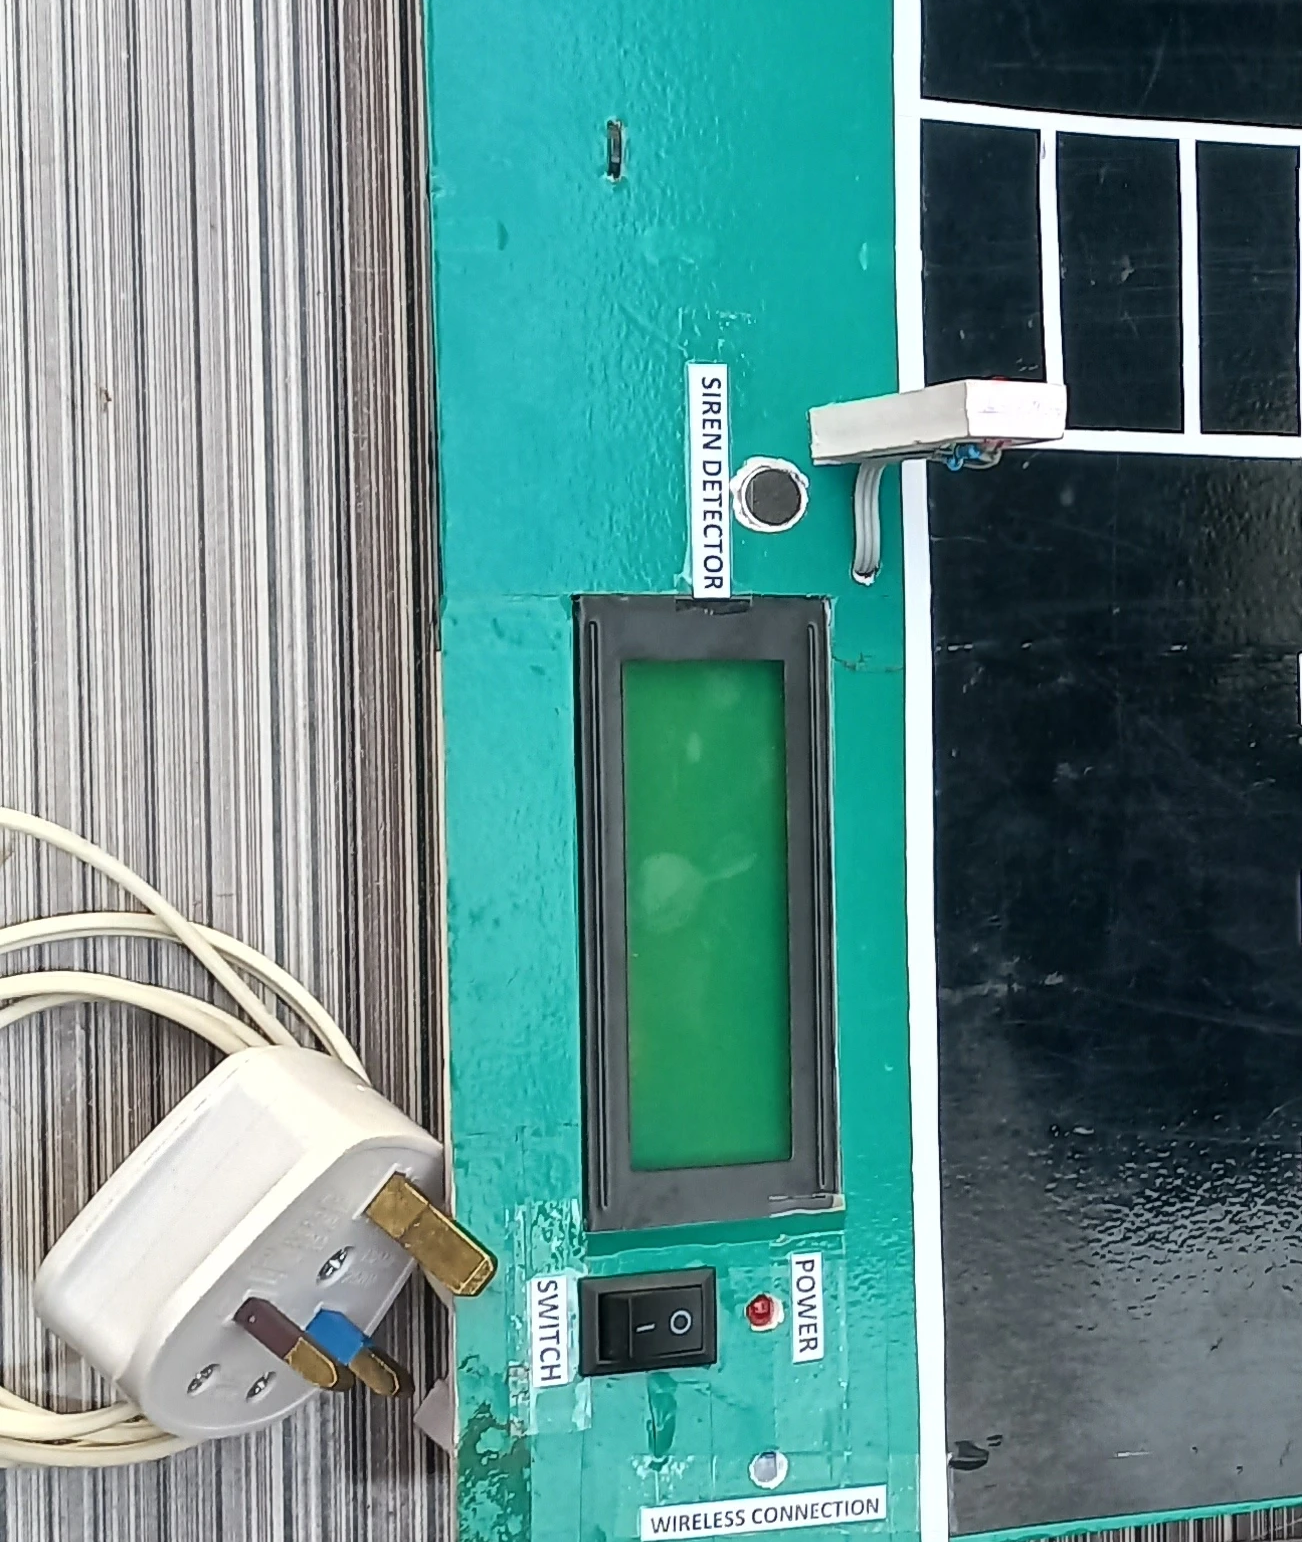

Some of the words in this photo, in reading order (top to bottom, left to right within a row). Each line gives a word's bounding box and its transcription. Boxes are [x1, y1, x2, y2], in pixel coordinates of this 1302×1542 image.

[701, 376, 722, 450] SIREN
[702, 460, 723, 589] DETECTOR
[537, 1280, 562, 1383] SWITCH
[795, 1259, 817, 1354] POWER
[651, 1510, 746, 1534] WIRELESS
[751, 1498, 880, 1525] CONNECTION
